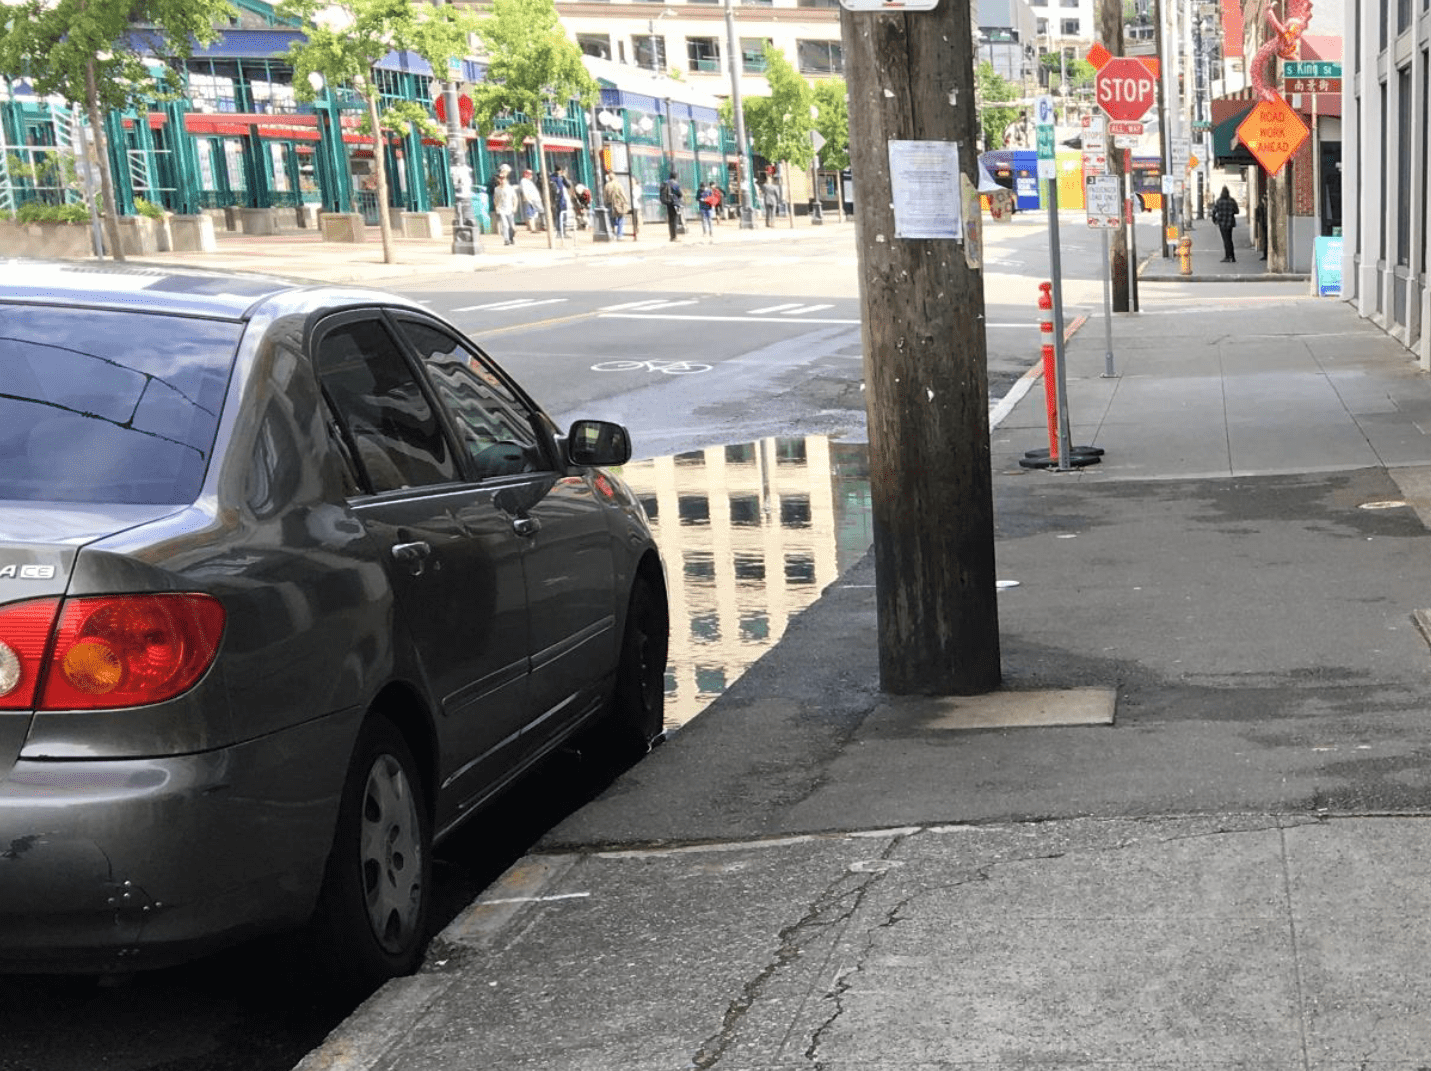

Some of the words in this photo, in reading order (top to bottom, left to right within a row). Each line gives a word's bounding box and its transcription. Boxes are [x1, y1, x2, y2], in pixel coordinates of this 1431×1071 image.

[1286, 65, 1293, 74] S
[1297, 61, 1318, 77] King
[1323, 65, 1332, 75] St
[1100, 77, 1151, 103] STOP
[1259, 111, 1286, 123] ROAD
[1110, 124, 1124, 134] ALL
[1128, 124, 1142, 134] WAY
[1259, 128, 1286, 139] WORK
[1257, 141, 1290, 153] AHEAD
[22, 566, 53, 578] CE
